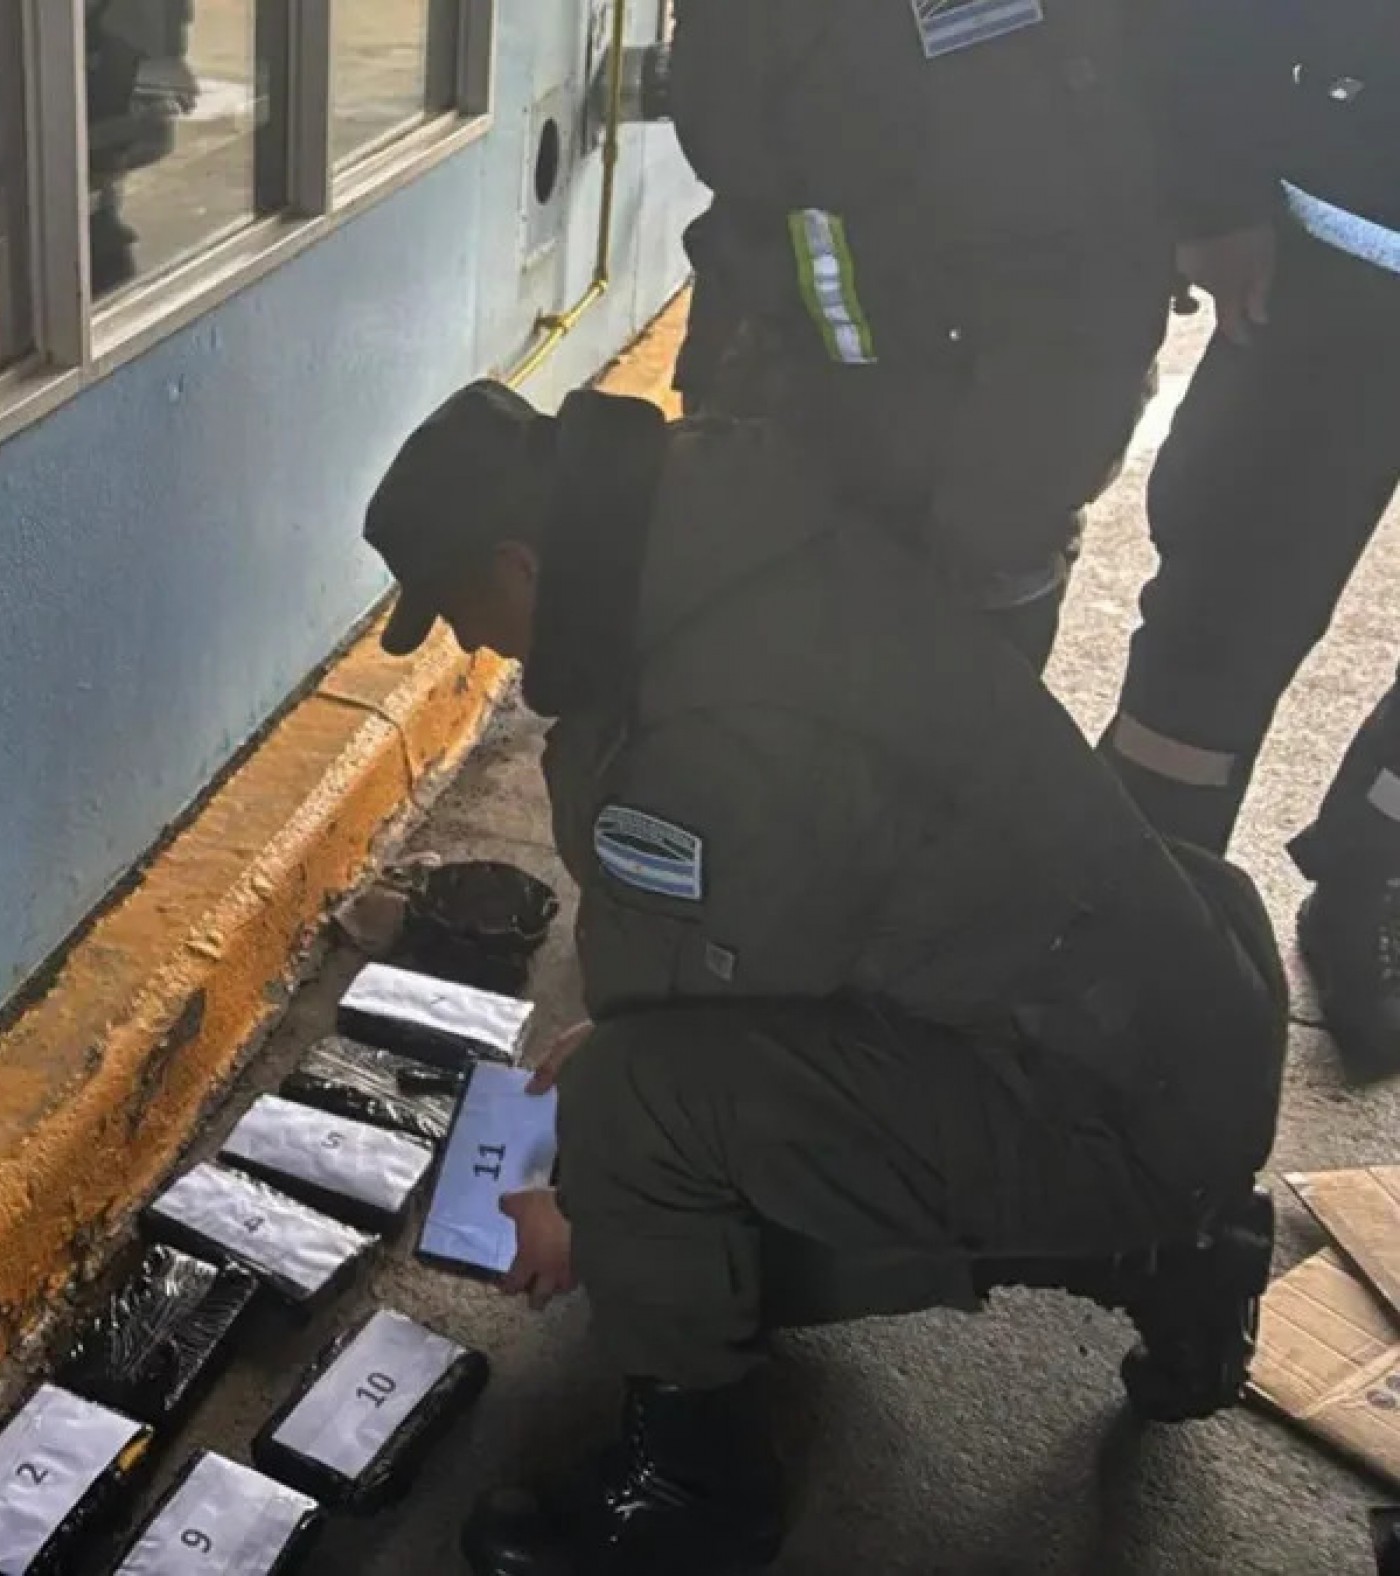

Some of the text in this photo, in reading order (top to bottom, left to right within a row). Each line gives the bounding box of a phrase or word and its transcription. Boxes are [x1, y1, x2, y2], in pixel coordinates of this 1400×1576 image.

[320, 1131, 346, 1149] 5
[473, 1143, 506, 1181] 11
[356, 1372, 396, 1408] 10
[16, 1463, 48, 1485] 2
[180, 1529, 211, 1553] 9
